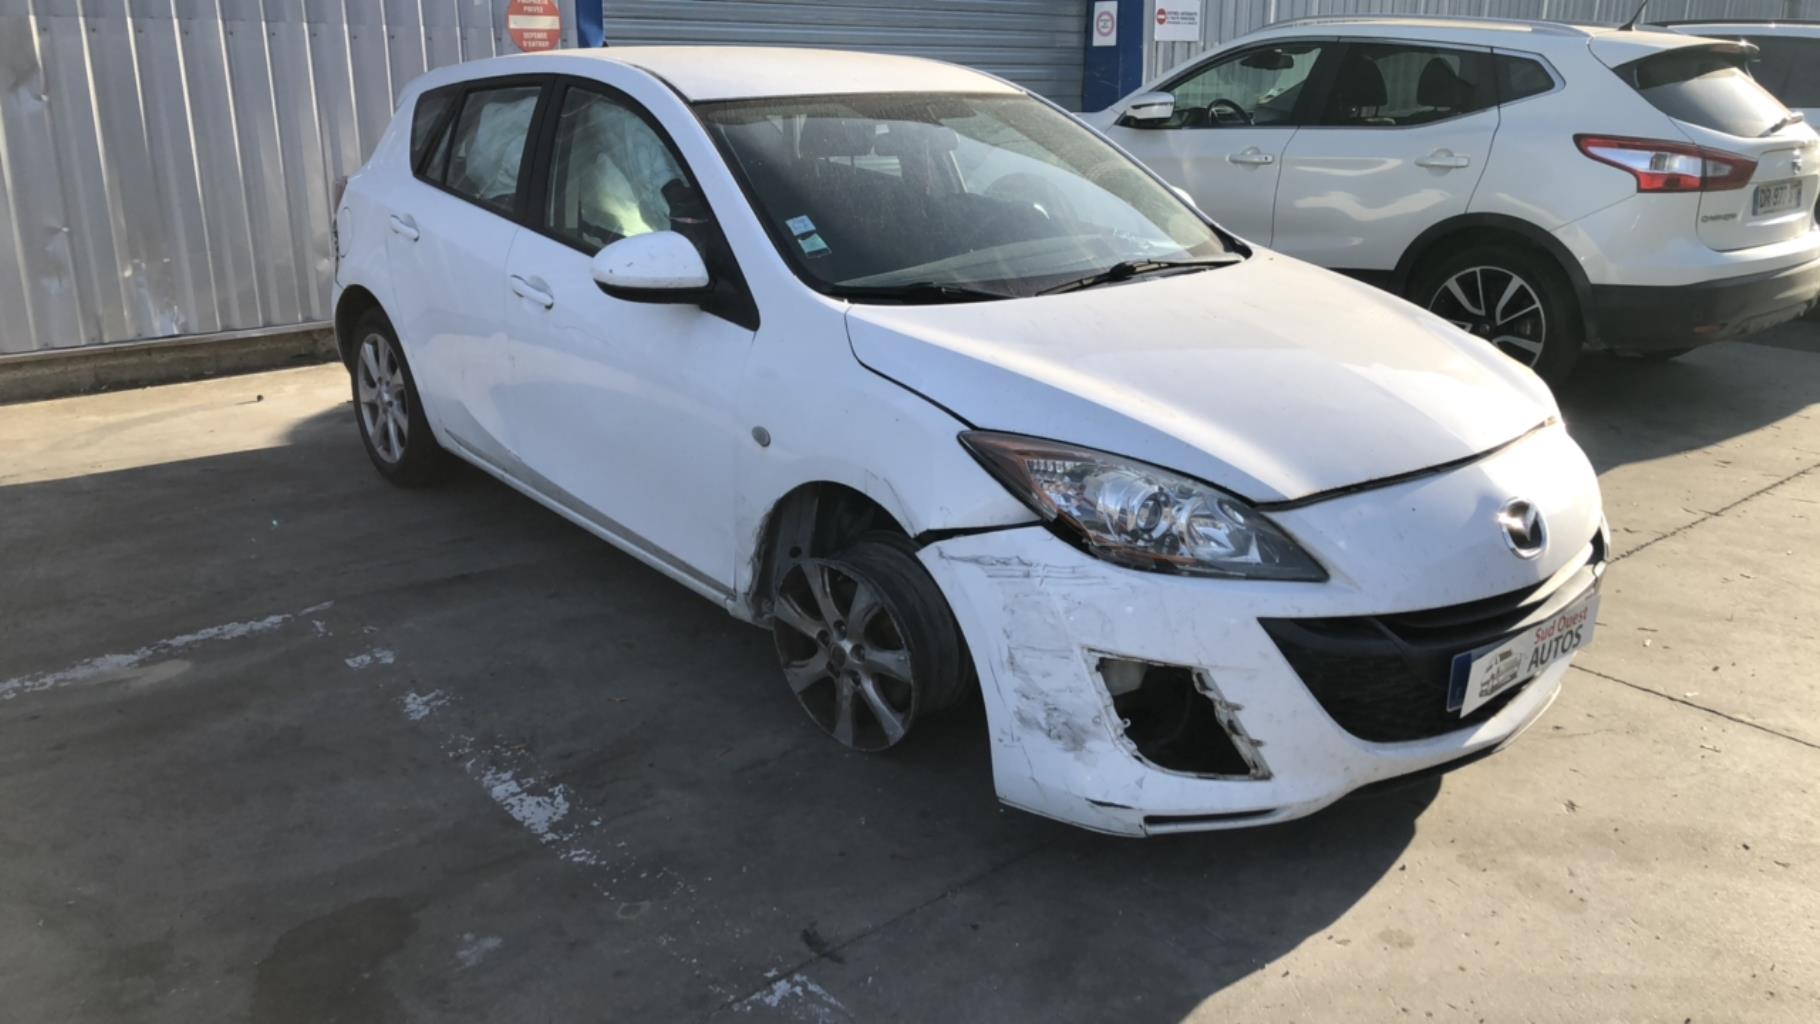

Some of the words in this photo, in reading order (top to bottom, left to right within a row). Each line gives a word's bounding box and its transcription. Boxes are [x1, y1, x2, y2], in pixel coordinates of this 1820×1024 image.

[1535, 622, 1556, 644] Sud
[1558, 607, 1588, 631] Ouest
[1527, 624, 1583, 673] AUTOS
